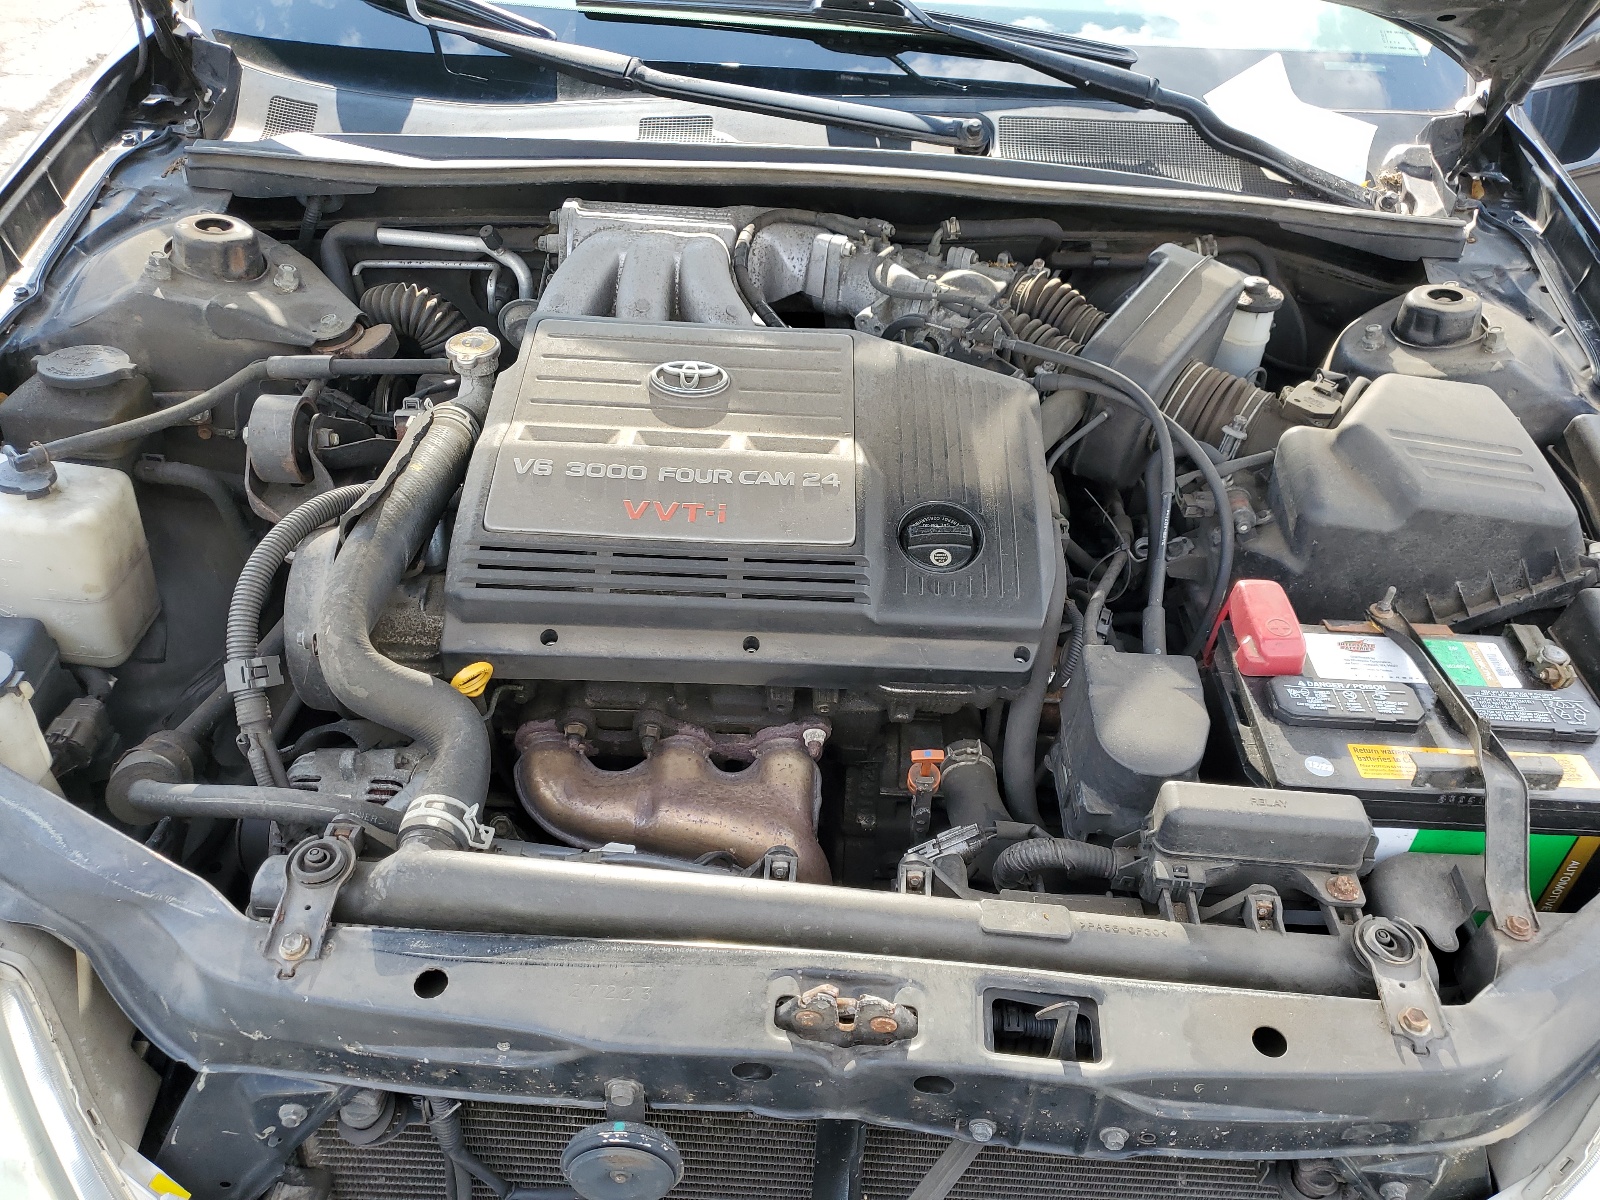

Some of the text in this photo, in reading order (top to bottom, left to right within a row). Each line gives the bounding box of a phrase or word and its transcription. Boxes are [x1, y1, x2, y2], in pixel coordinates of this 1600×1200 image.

[513, 457, 841, 488] V6 3000 FOUR CAM 24
[623, 499, 728, 523] VVT-i
[1307, 681, 1344, 689] DANGER
[1351, 683, 1387, 691] POISON
[1353, 747, 1380, 755] Return
[1356, 755, 1392, 763] batteries
[1250, 797, 1288, 808] RELAY
[1540, 860, 1581, 911] AUTOMOTIVE
